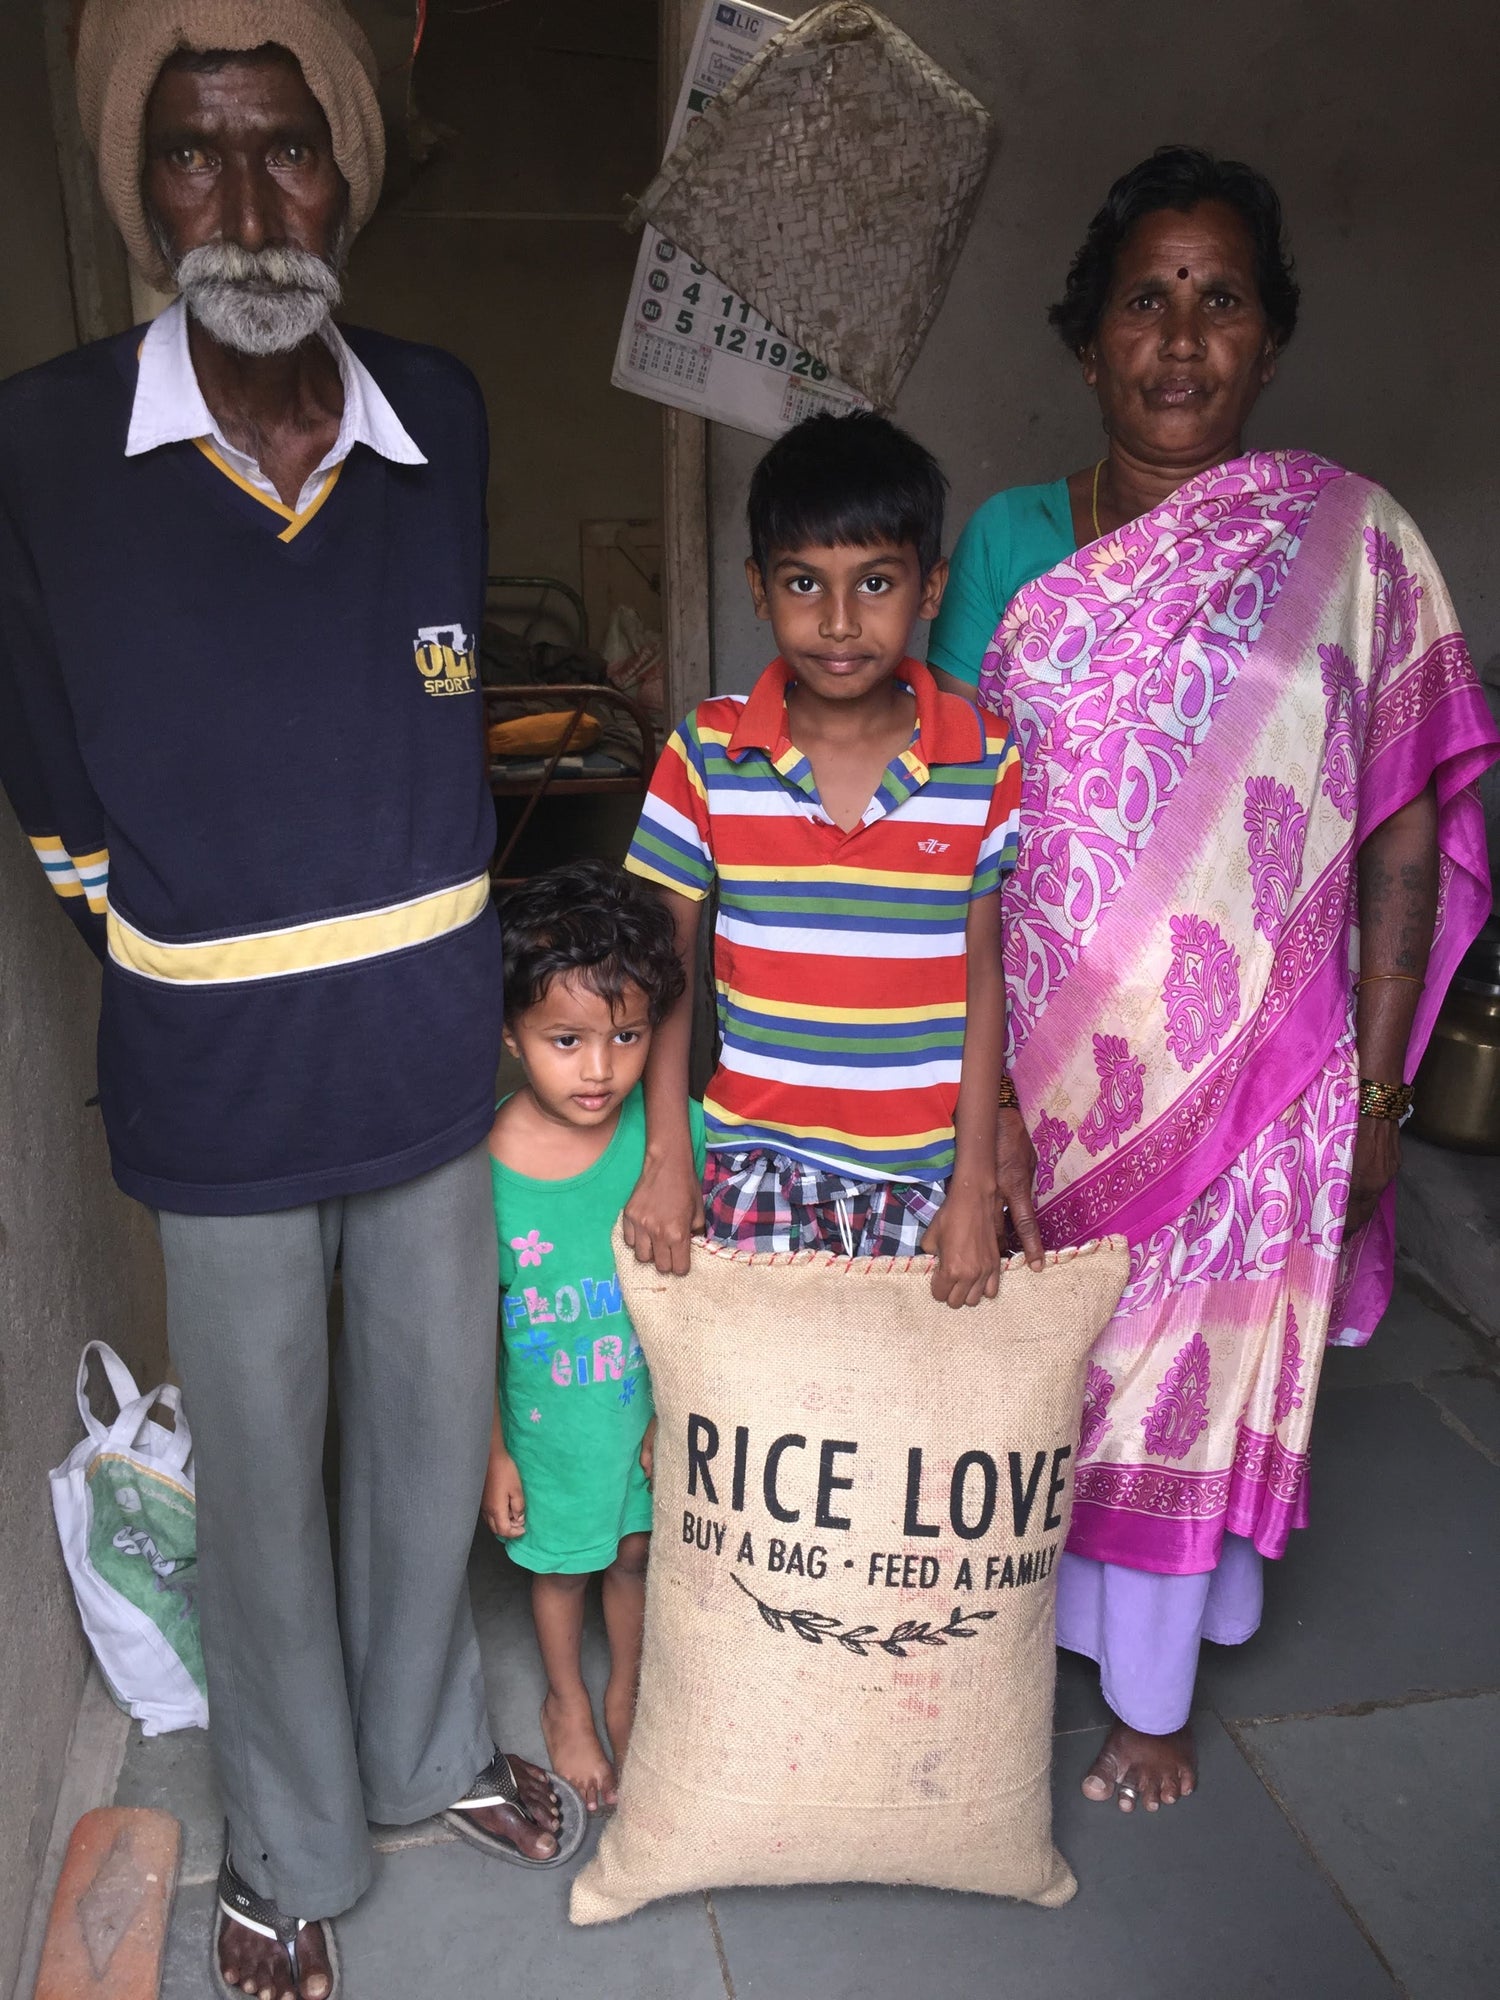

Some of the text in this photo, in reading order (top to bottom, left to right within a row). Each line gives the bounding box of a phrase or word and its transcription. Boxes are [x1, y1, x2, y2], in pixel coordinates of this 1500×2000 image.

[736, 14, 760, 34] LIC
[651, 273, 751, 324] FRI 4 11
[644, 303, 660, 318] SAT
[675, 310, 694, 335] 5
[714, 324, 747, 354] 12
[756, 338, 788, 367] 19
[792, 352, 828, 381] 26
[424, 676, 470, 694] SPORT
[687, 1412, 1071, 1540] RICE LOVE
[682, 1510, 1058, 1592] BUY A BAG FEED A FAMILY
